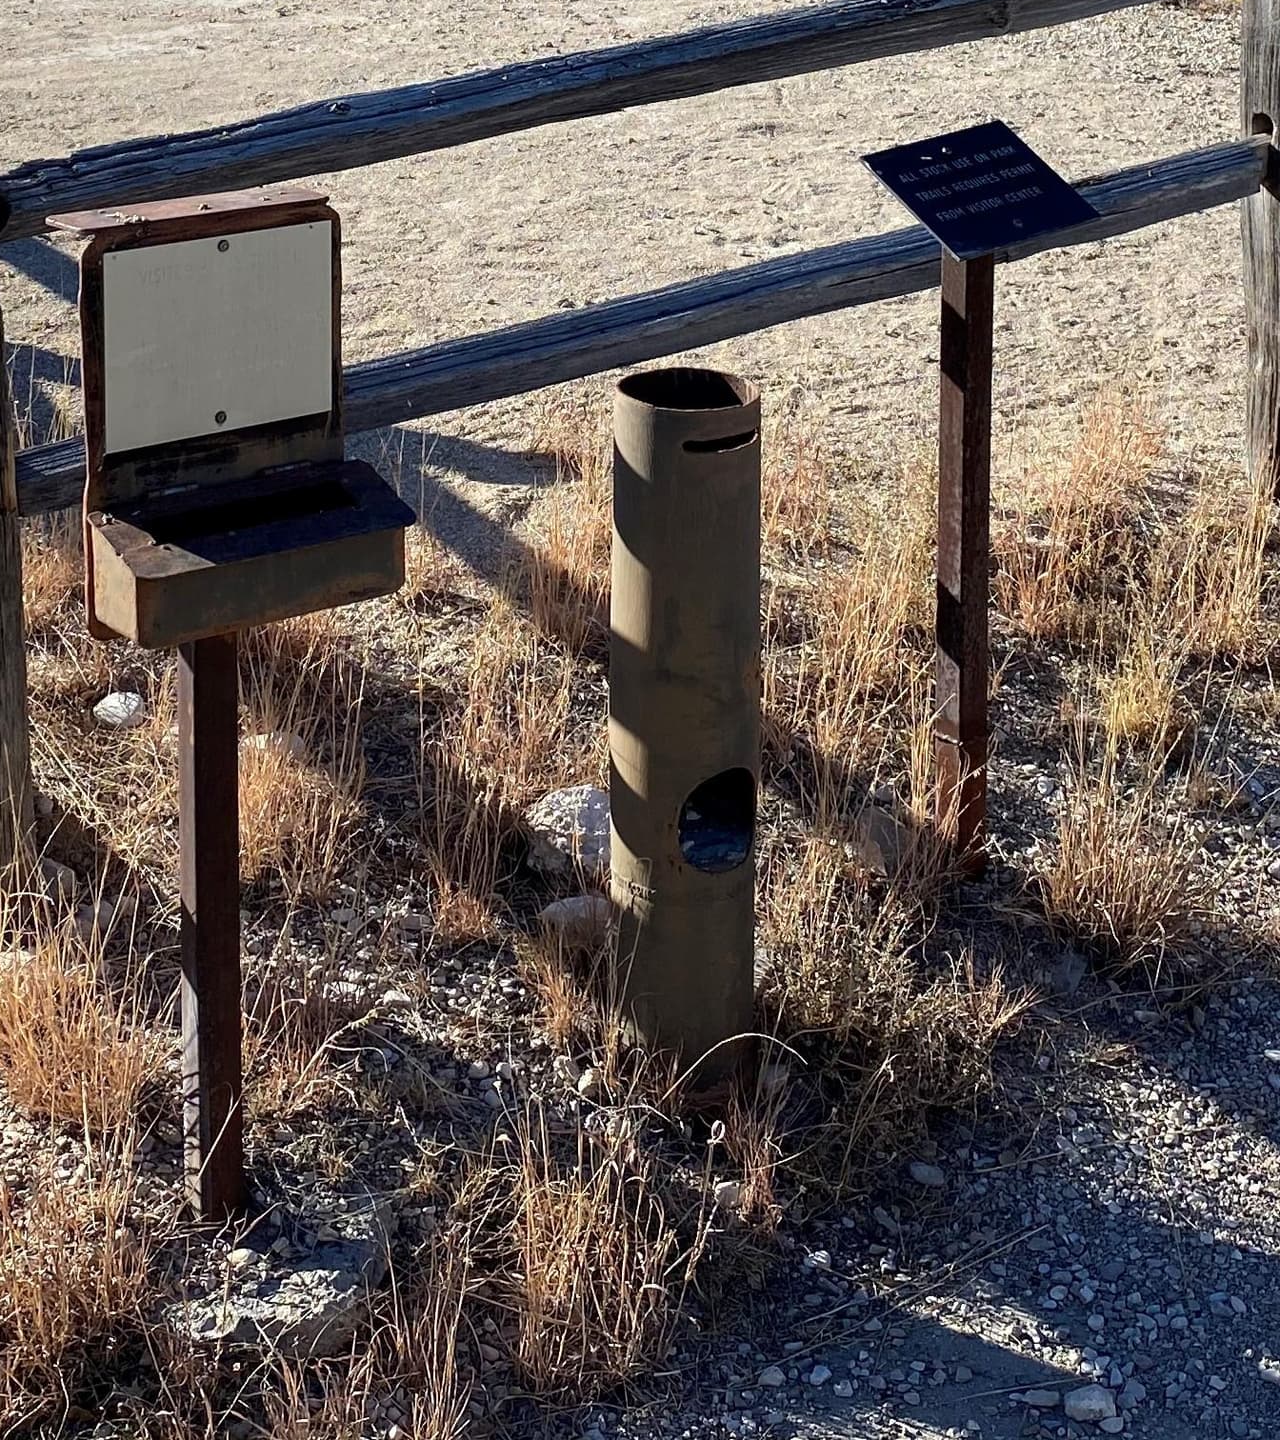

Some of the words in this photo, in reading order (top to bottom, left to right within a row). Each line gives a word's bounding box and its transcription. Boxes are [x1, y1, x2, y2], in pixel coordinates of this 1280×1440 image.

[899, 171, 919, 184] ALL
[919, 163, 950, 179] STOCK
[952, 156, 974, 169] USE
[974, 152, 990, 162] ON
[990, 145, 1016, 158] PARK
[916, 186, 952, 202] TRAILS
[952, 172, 1000, 192] REQUIRES
[999, 162, 1036, 180] PERMIT
[936, 206, 966, 222] FROM
[967, 197, 1003, 214] VISITOR
[1005, 186, 1043, 203] CENTER
